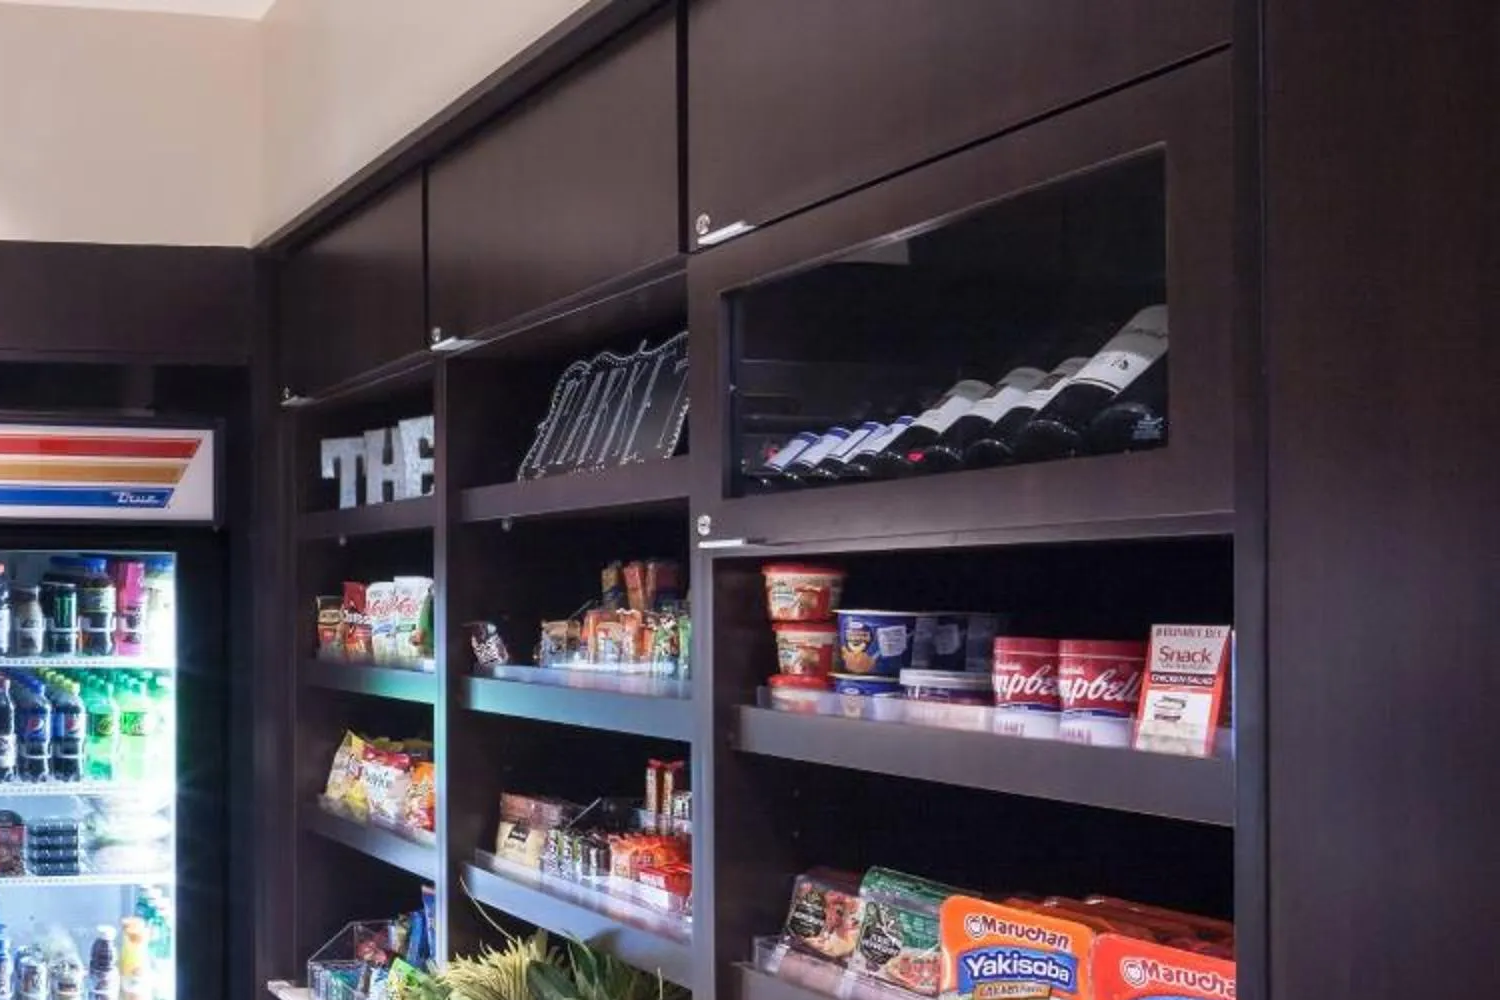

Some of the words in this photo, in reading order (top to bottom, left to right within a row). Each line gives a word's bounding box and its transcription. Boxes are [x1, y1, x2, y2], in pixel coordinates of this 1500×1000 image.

[321, 415, 435, 508] THE
[1158, 645, 1212, 664] Snack
[981, 915, 1070, 949] Maruchan
[965, 952, 1070, 983] Yakisoba
[1141, 959, 1236, 998] Marucha
